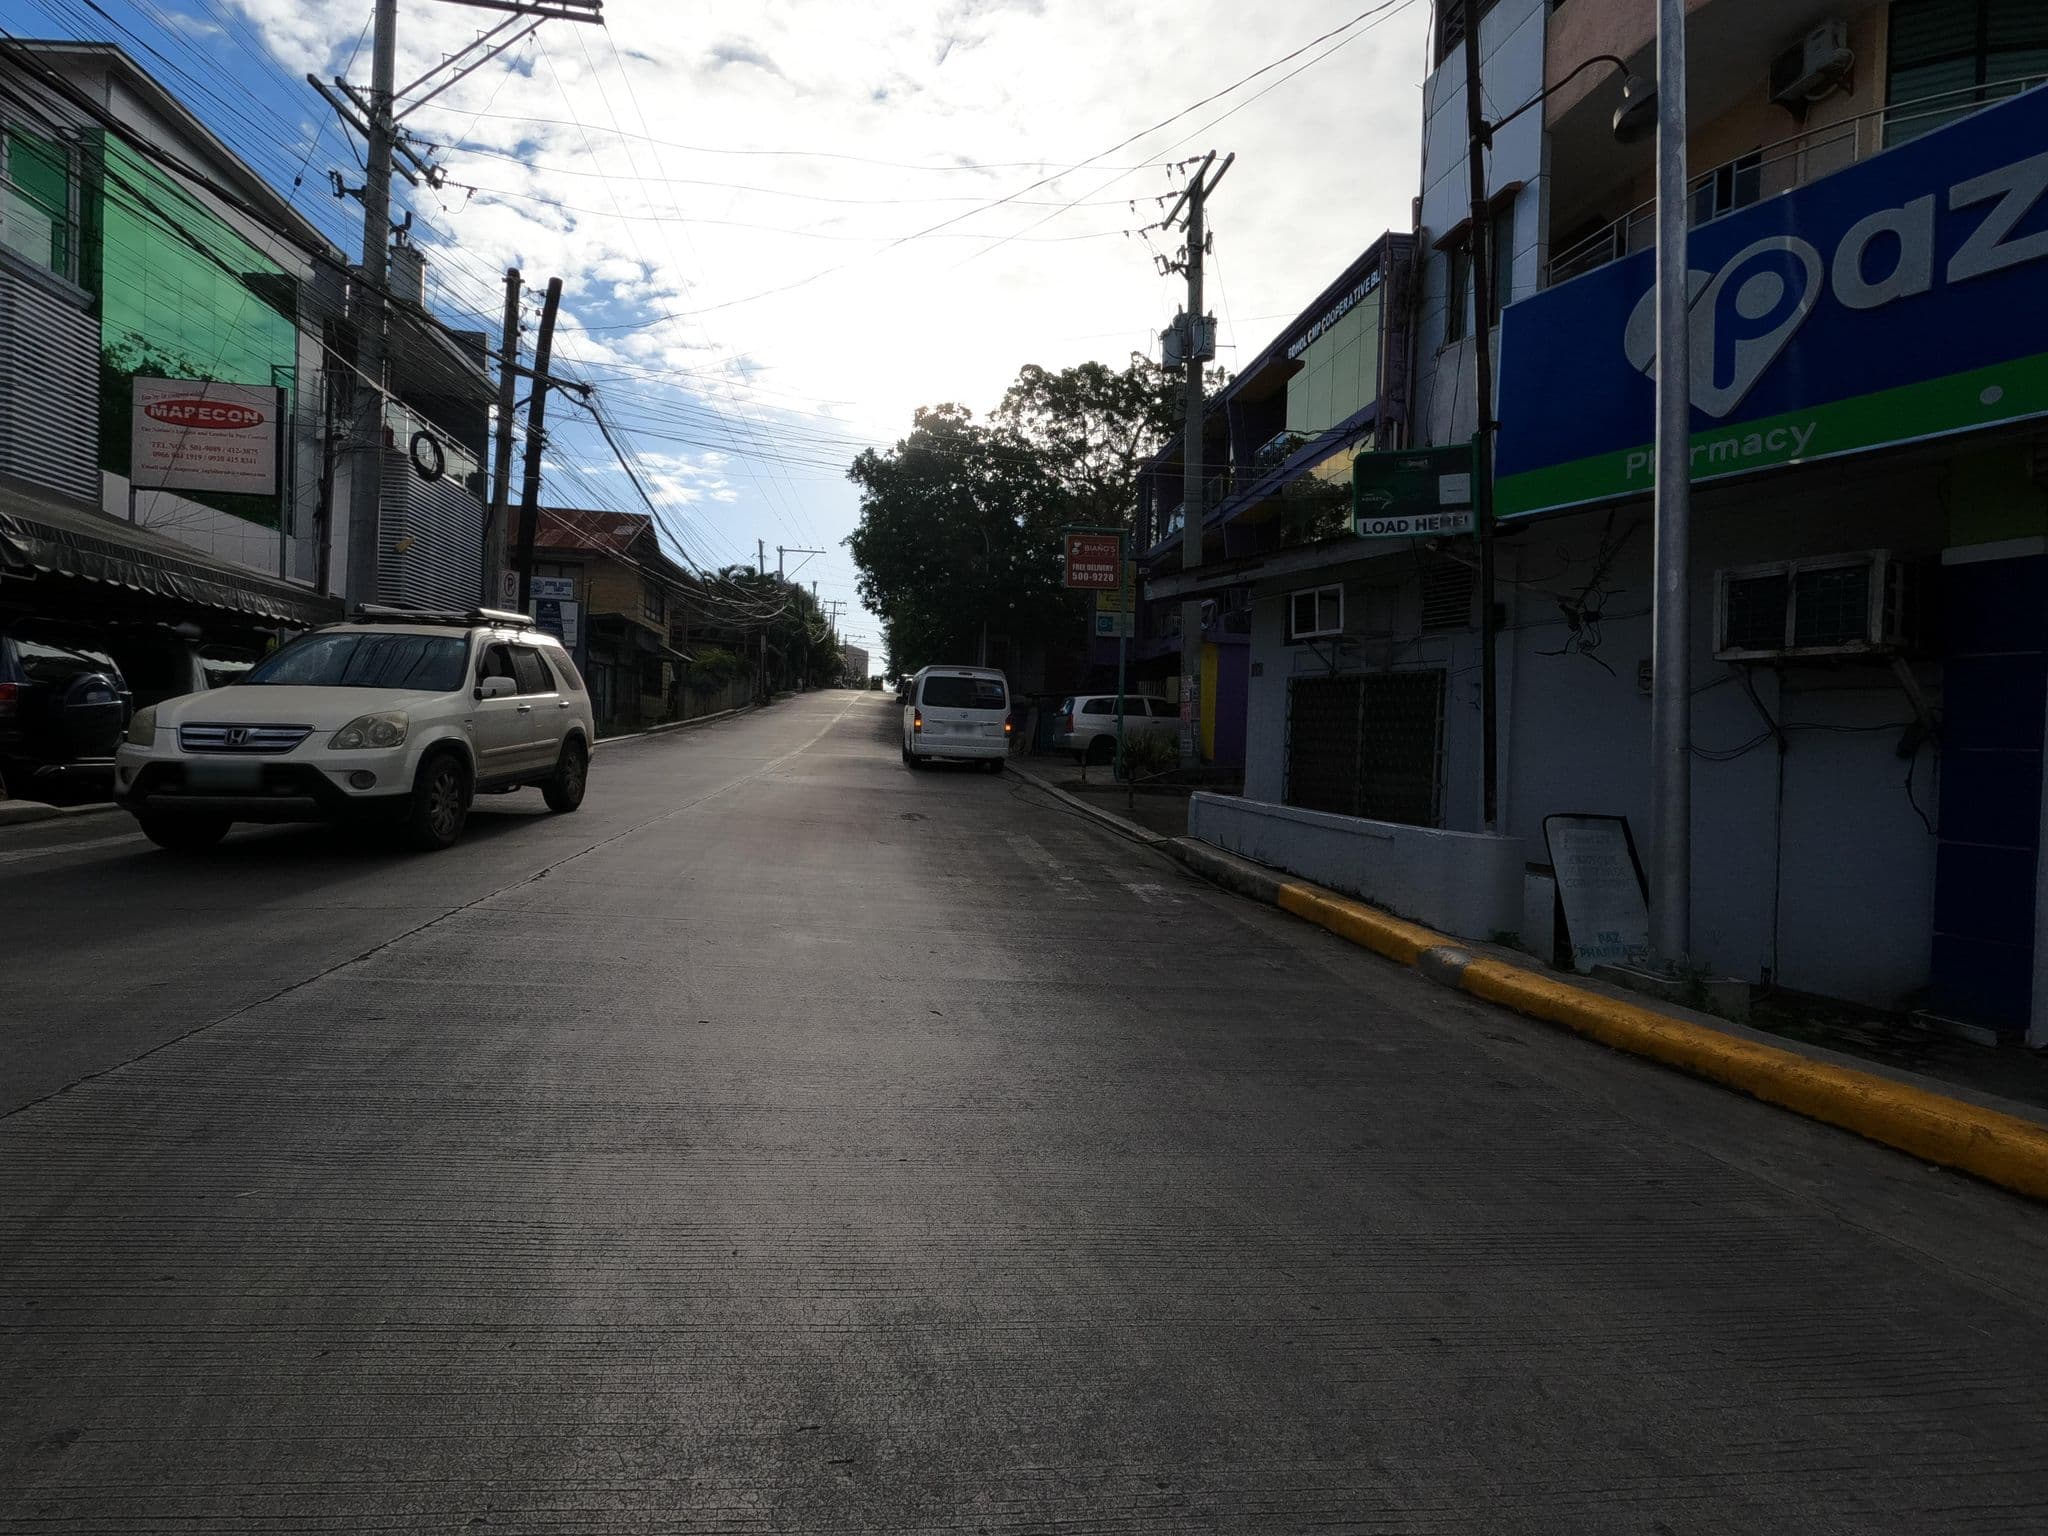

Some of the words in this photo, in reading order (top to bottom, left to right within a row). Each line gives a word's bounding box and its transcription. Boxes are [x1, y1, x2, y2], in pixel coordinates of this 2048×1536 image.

[1321, 276, 1370, 334] COOPERATIVE
[150, 404, 259, 424] MAPECON
[1626, 421, 1817, 480] Prmacy
[1363, 520, 1409, 534] LOAD
[1087, 563, 1114, 572] DELIVERY
